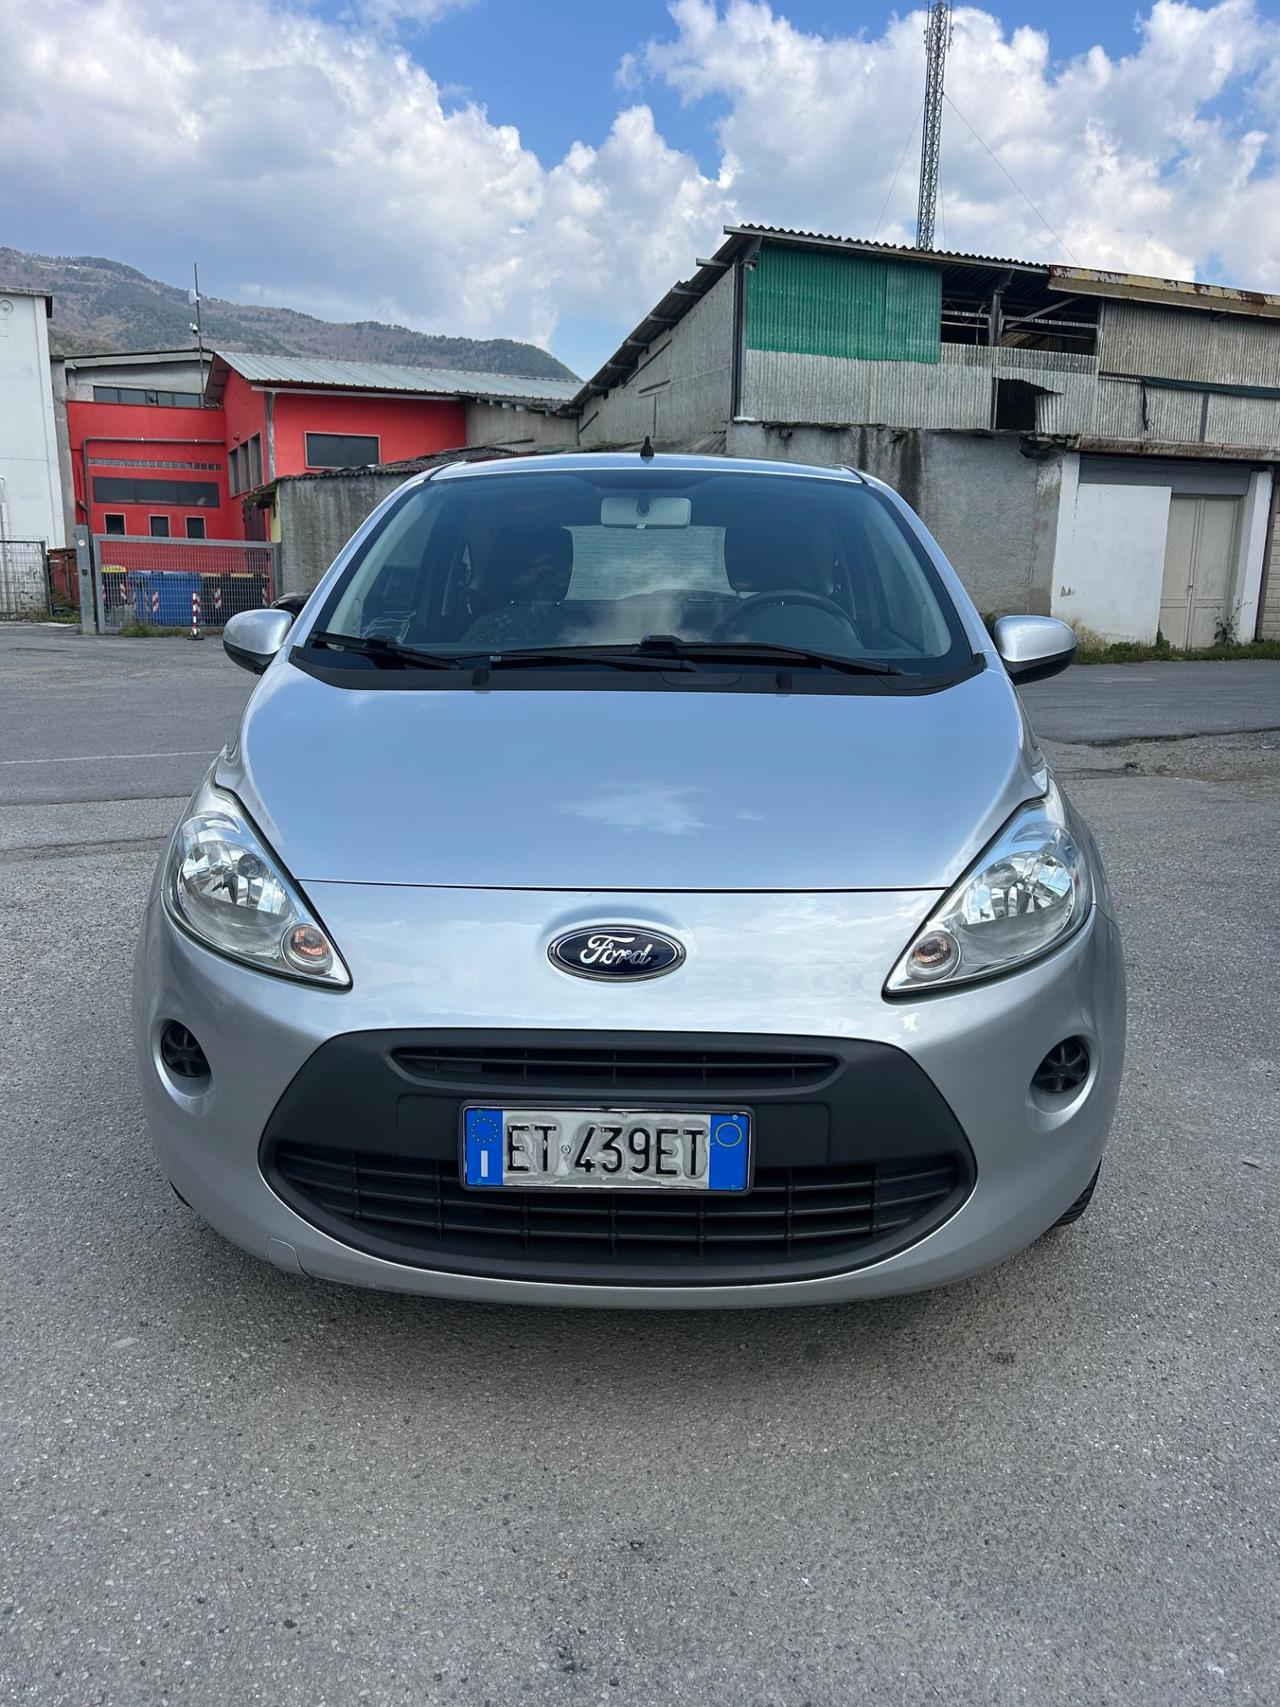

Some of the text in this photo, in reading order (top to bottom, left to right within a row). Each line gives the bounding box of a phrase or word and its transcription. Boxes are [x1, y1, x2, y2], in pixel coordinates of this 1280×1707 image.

[579, 934, 653, 965] Ford
[507, 1125, 705, 1176] ET 439ET
